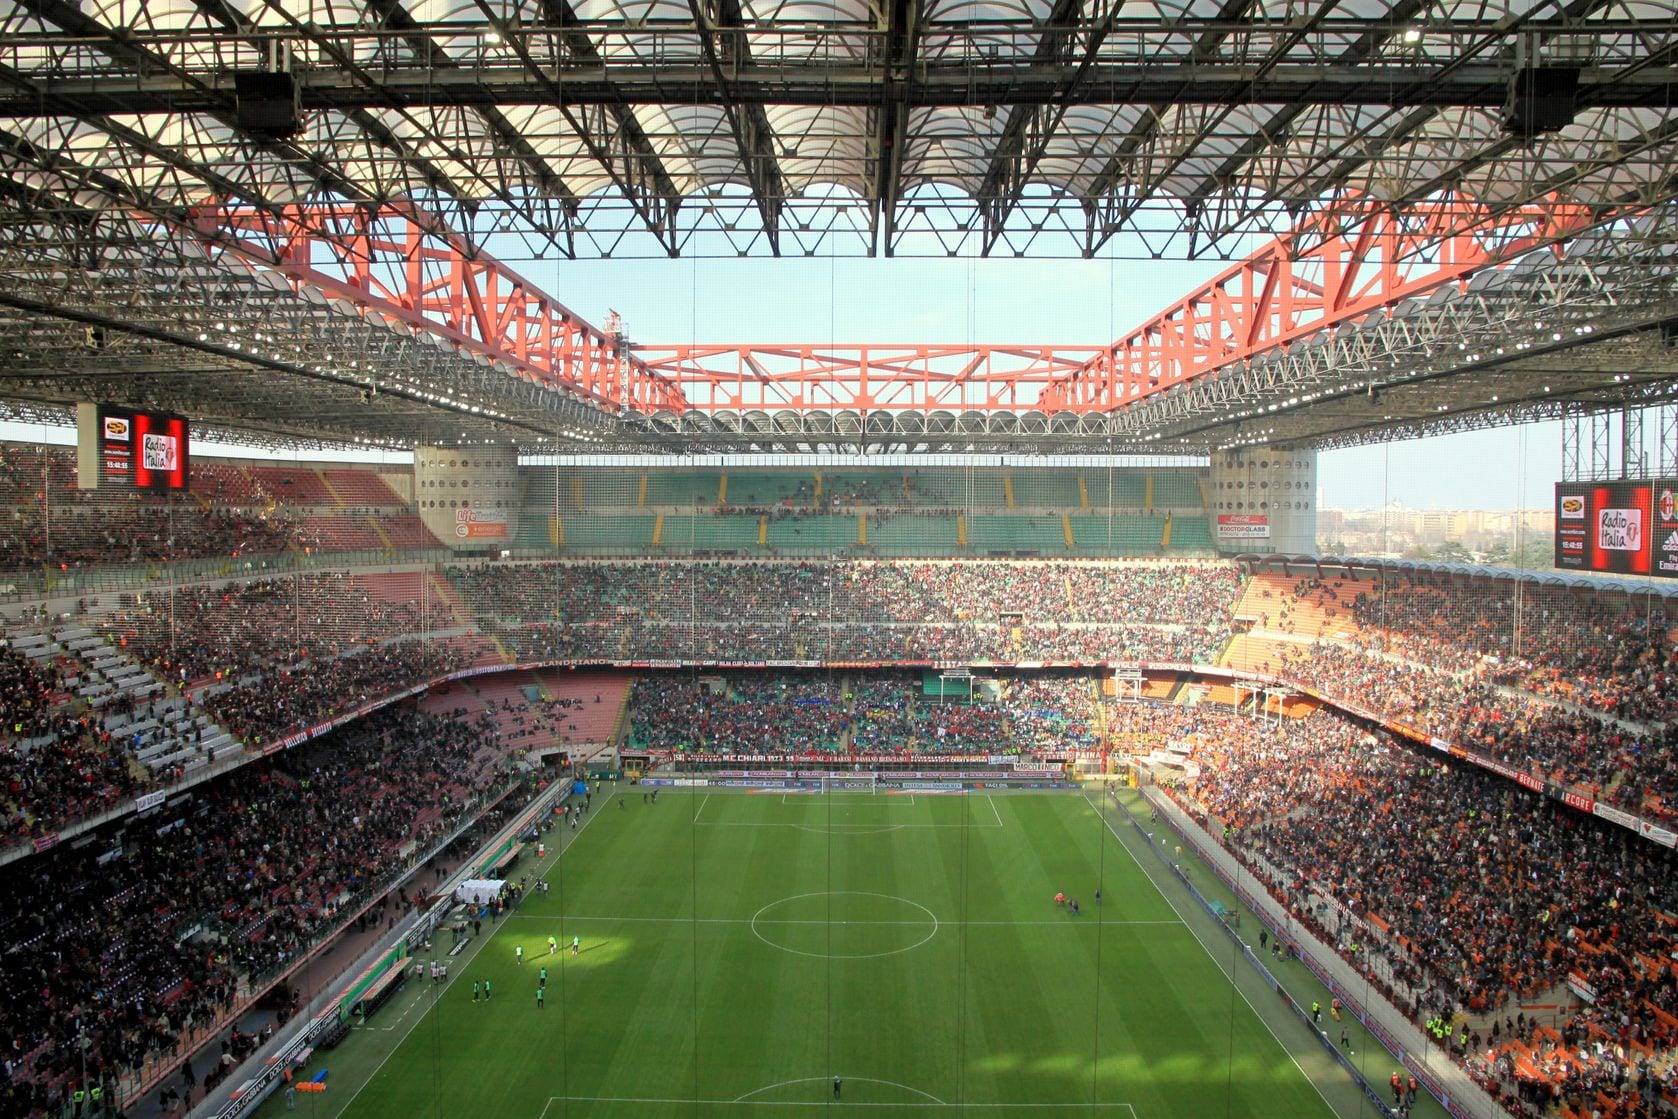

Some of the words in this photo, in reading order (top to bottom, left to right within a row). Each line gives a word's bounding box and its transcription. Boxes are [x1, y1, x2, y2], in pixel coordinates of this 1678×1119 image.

[145, 437, 166, 452] Radio
[145, 452, 165, 467] Italia
[1602, 512, 1627, 528] Radio
[1601, 529, 1626, 547] Italia
[543, 659, 606, 667] LANDRIANO
[1519, 773, 1545, 793] BERNATE
[1560, 791, 1590, 811] ARCORE
[241, 1079, 267, 1107] GABBANA
